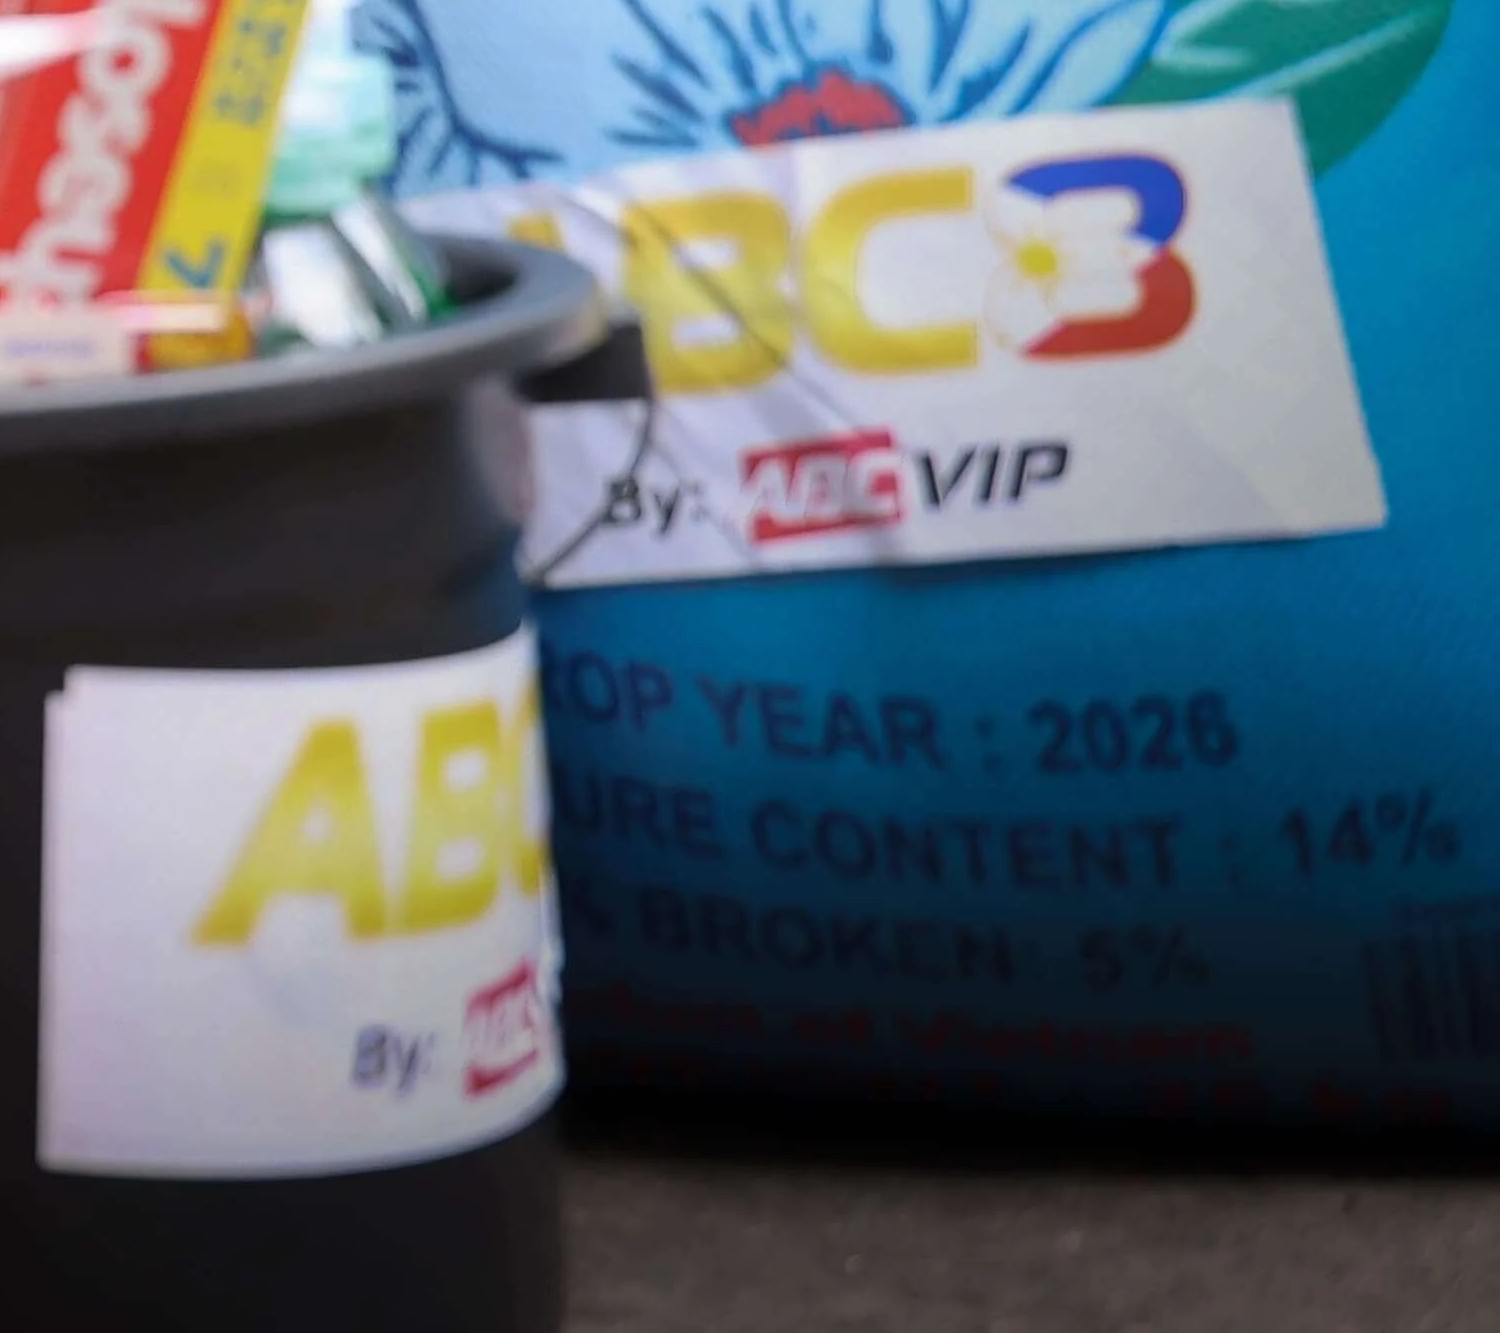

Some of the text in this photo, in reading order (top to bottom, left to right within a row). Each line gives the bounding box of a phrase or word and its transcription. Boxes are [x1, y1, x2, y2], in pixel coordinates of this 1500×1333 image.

[510, 153, 1197, 398] BC3
[605, 472, 704, 537] By:
[915, 443, 1071, 507] VIP
[695, 669, 947, 773] YEAR
[749, 797, 1188, 891] CONTENT
